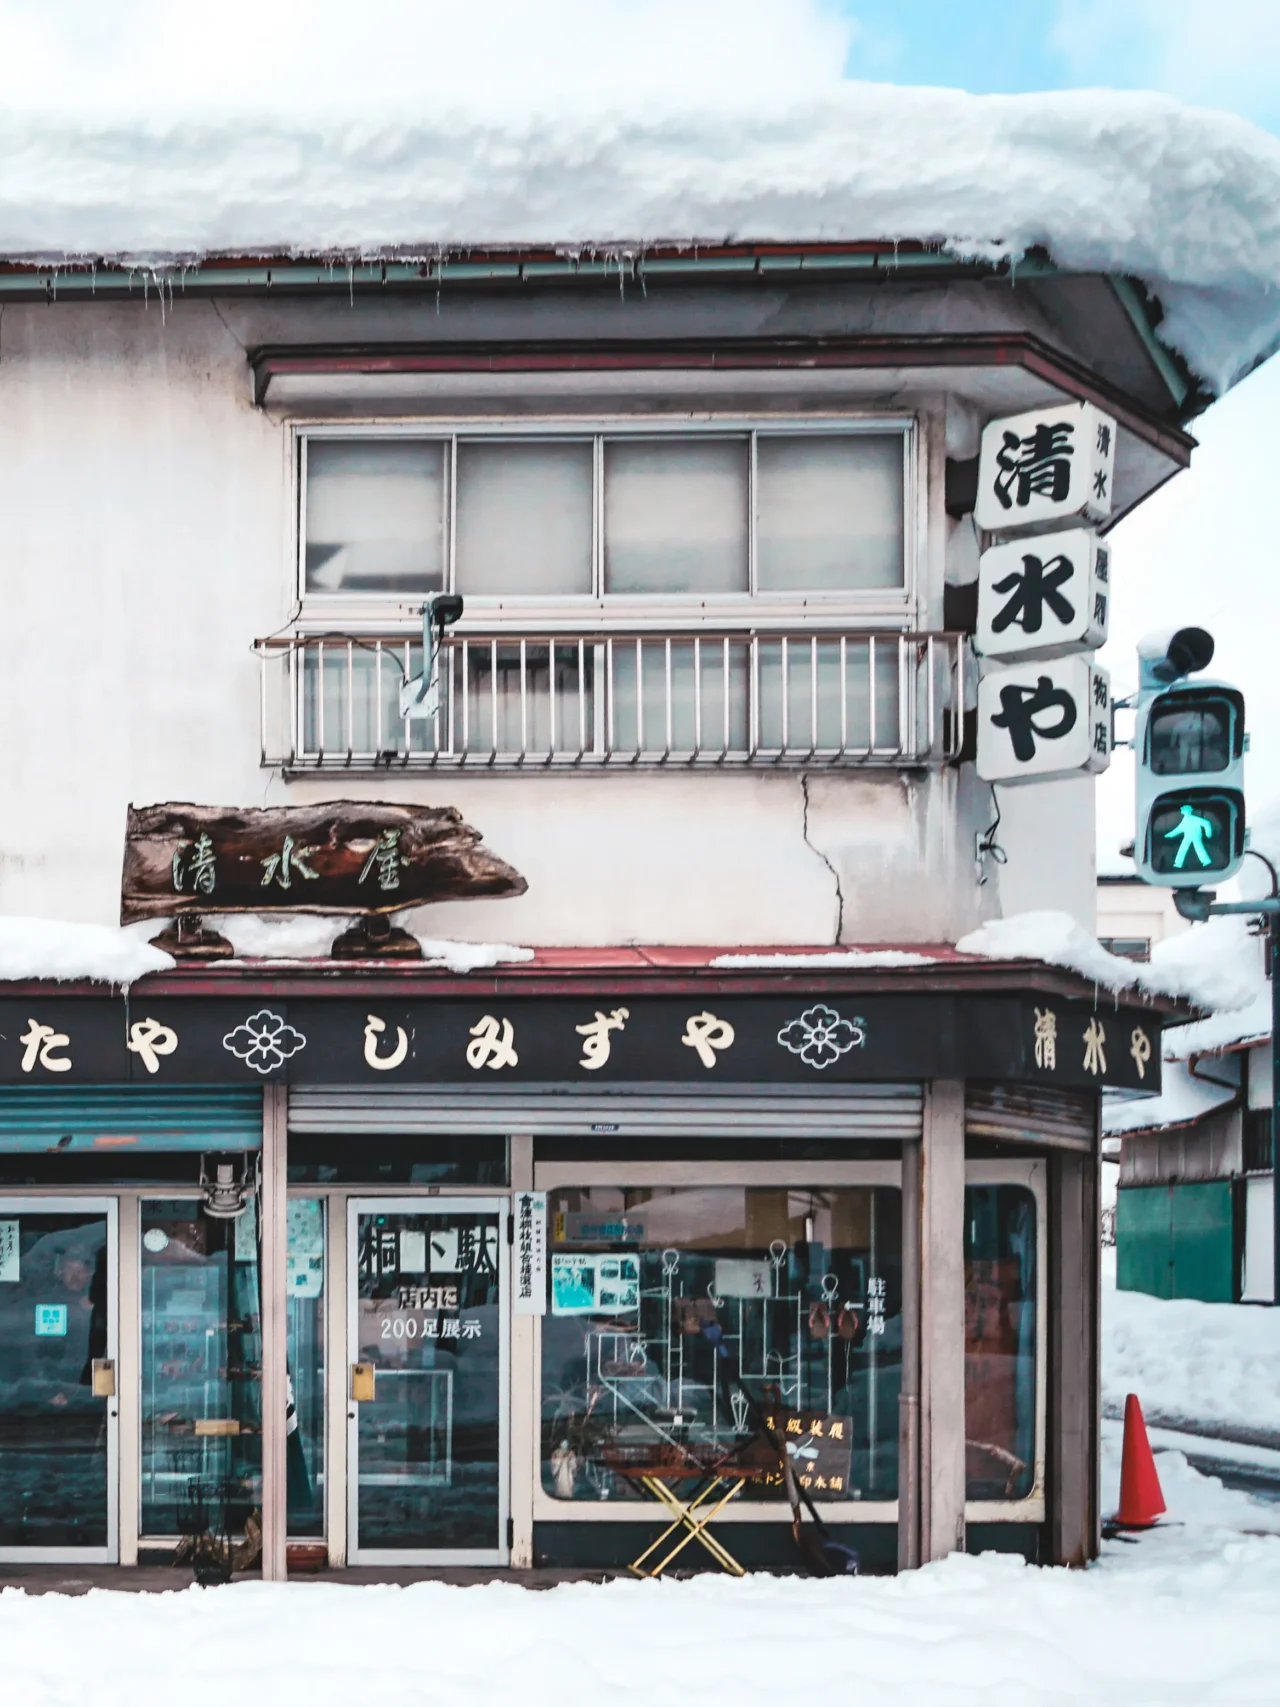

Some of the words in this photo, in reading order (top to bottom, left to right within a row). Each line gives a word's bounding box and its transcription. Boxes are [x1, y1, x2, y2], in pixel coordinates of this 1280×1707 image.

[990, 422, 1077, 762] 清水や
[172, 828, 411, 894] 清水屋
[363, 1007, 735, 1071] しみずや
[1033, 1006, 1151, 1080] 清水や
[359, 1226, 498, 1280] 桐下駄
[381, 1318, 482, 1339] 200足展示
[398, 1287, 459, 1310] 店内に
[866, 1277, 887, 1336] 駐車場
